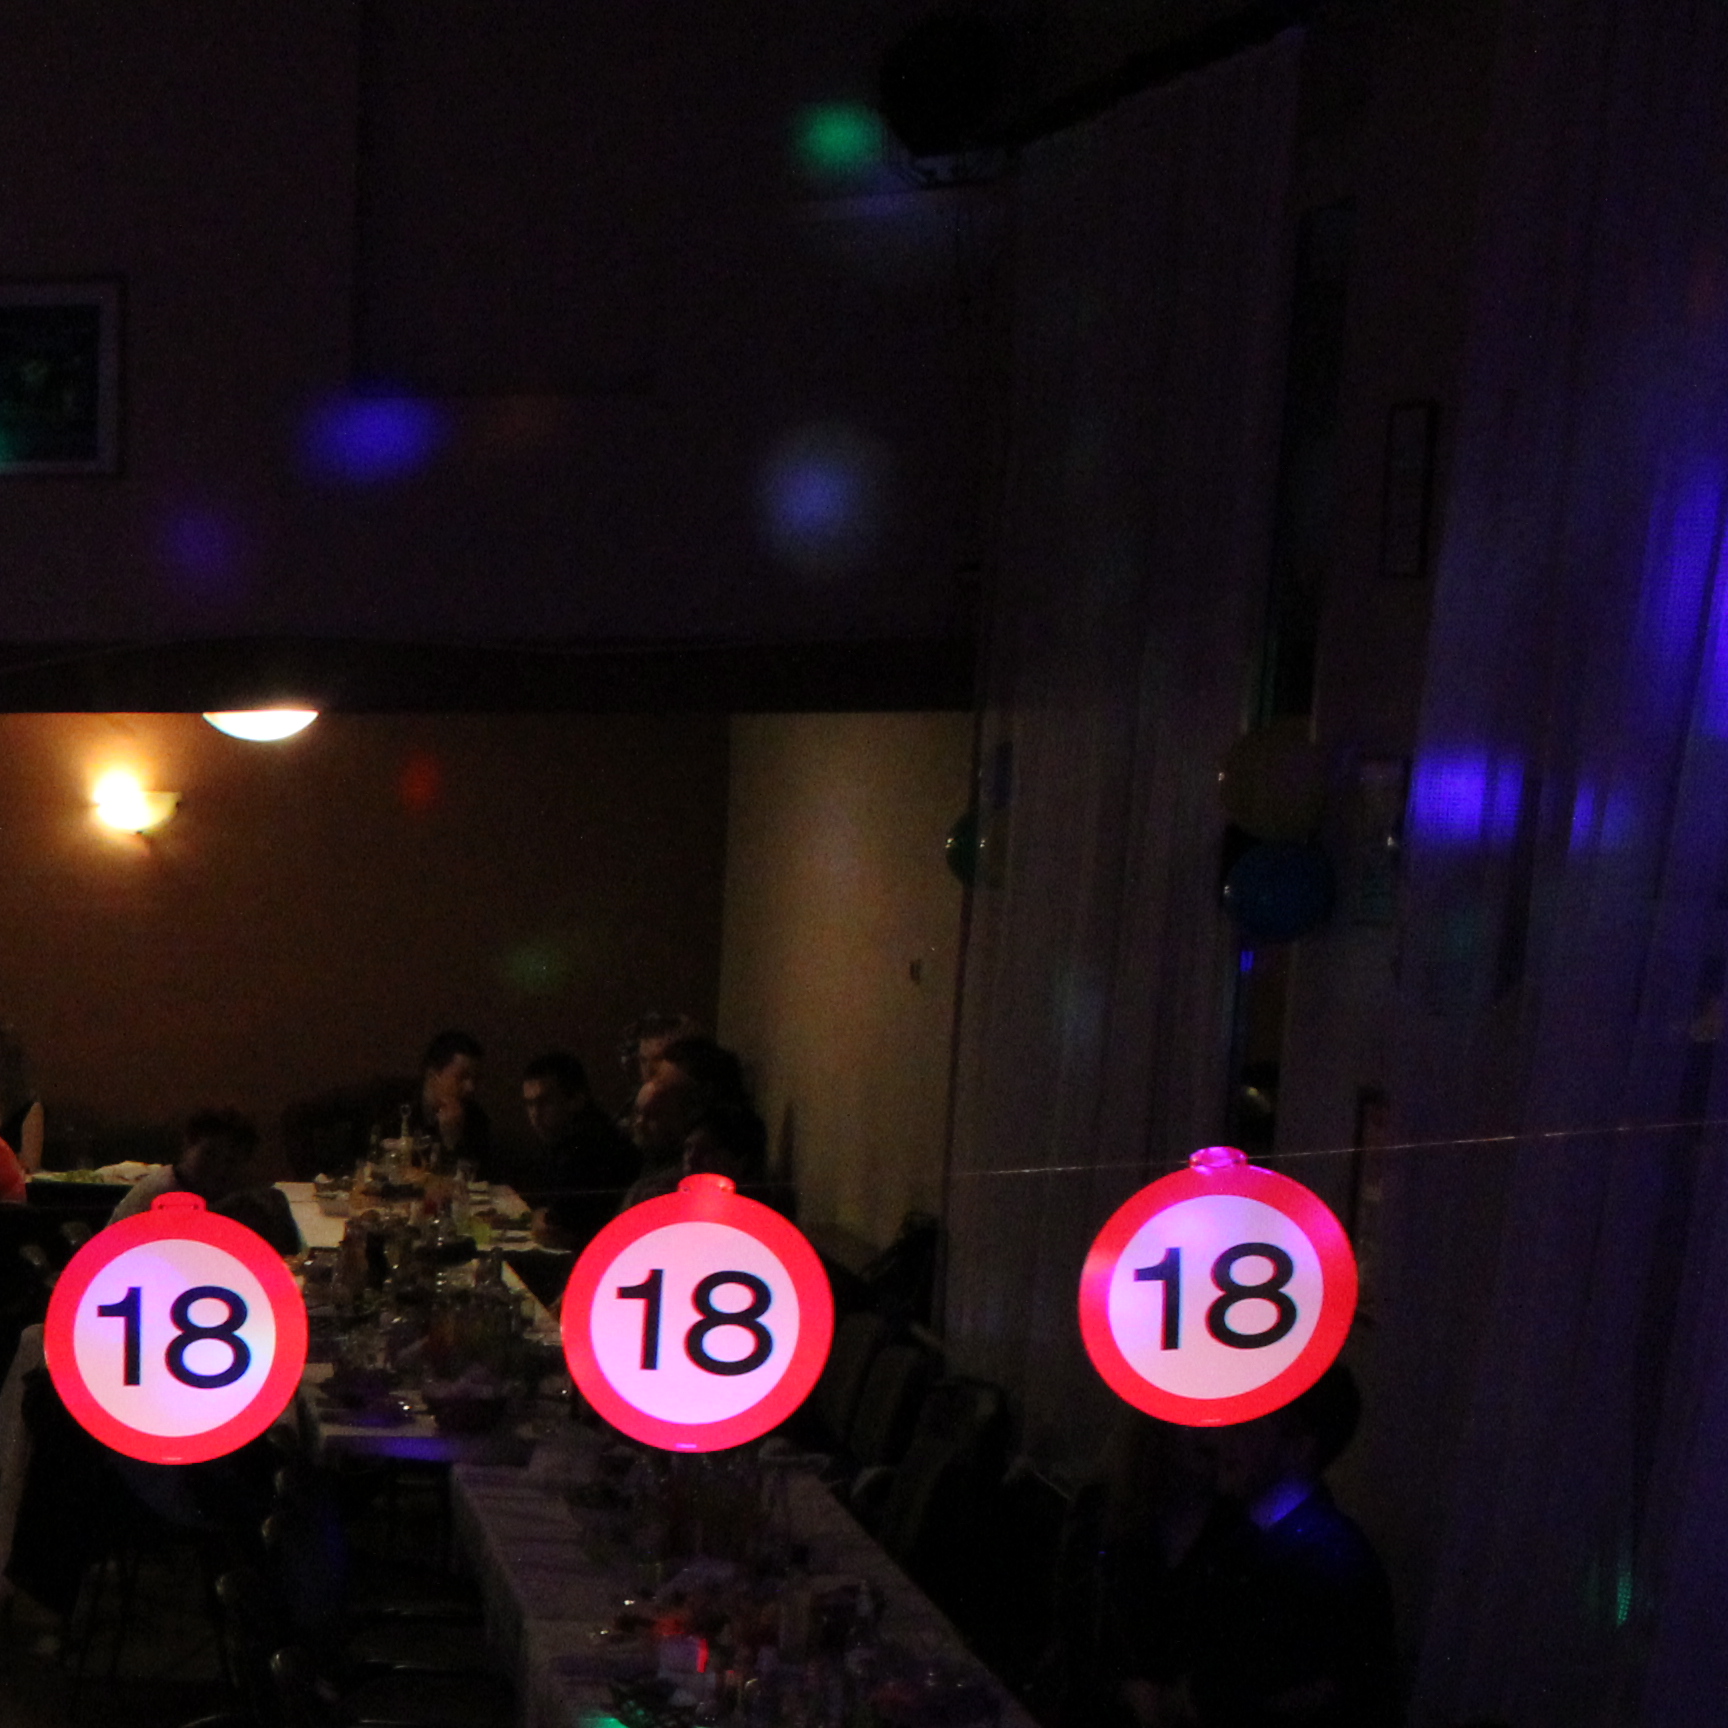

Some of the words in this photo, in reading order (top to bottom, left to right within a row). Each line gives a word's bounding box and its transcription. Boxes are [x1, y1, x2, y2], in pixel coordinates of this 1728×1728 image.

[97, 1286, 250, 1389] 18
[617, 1269, 773, 1376] 18
[1134, 1242, 1297, 1350] 18
